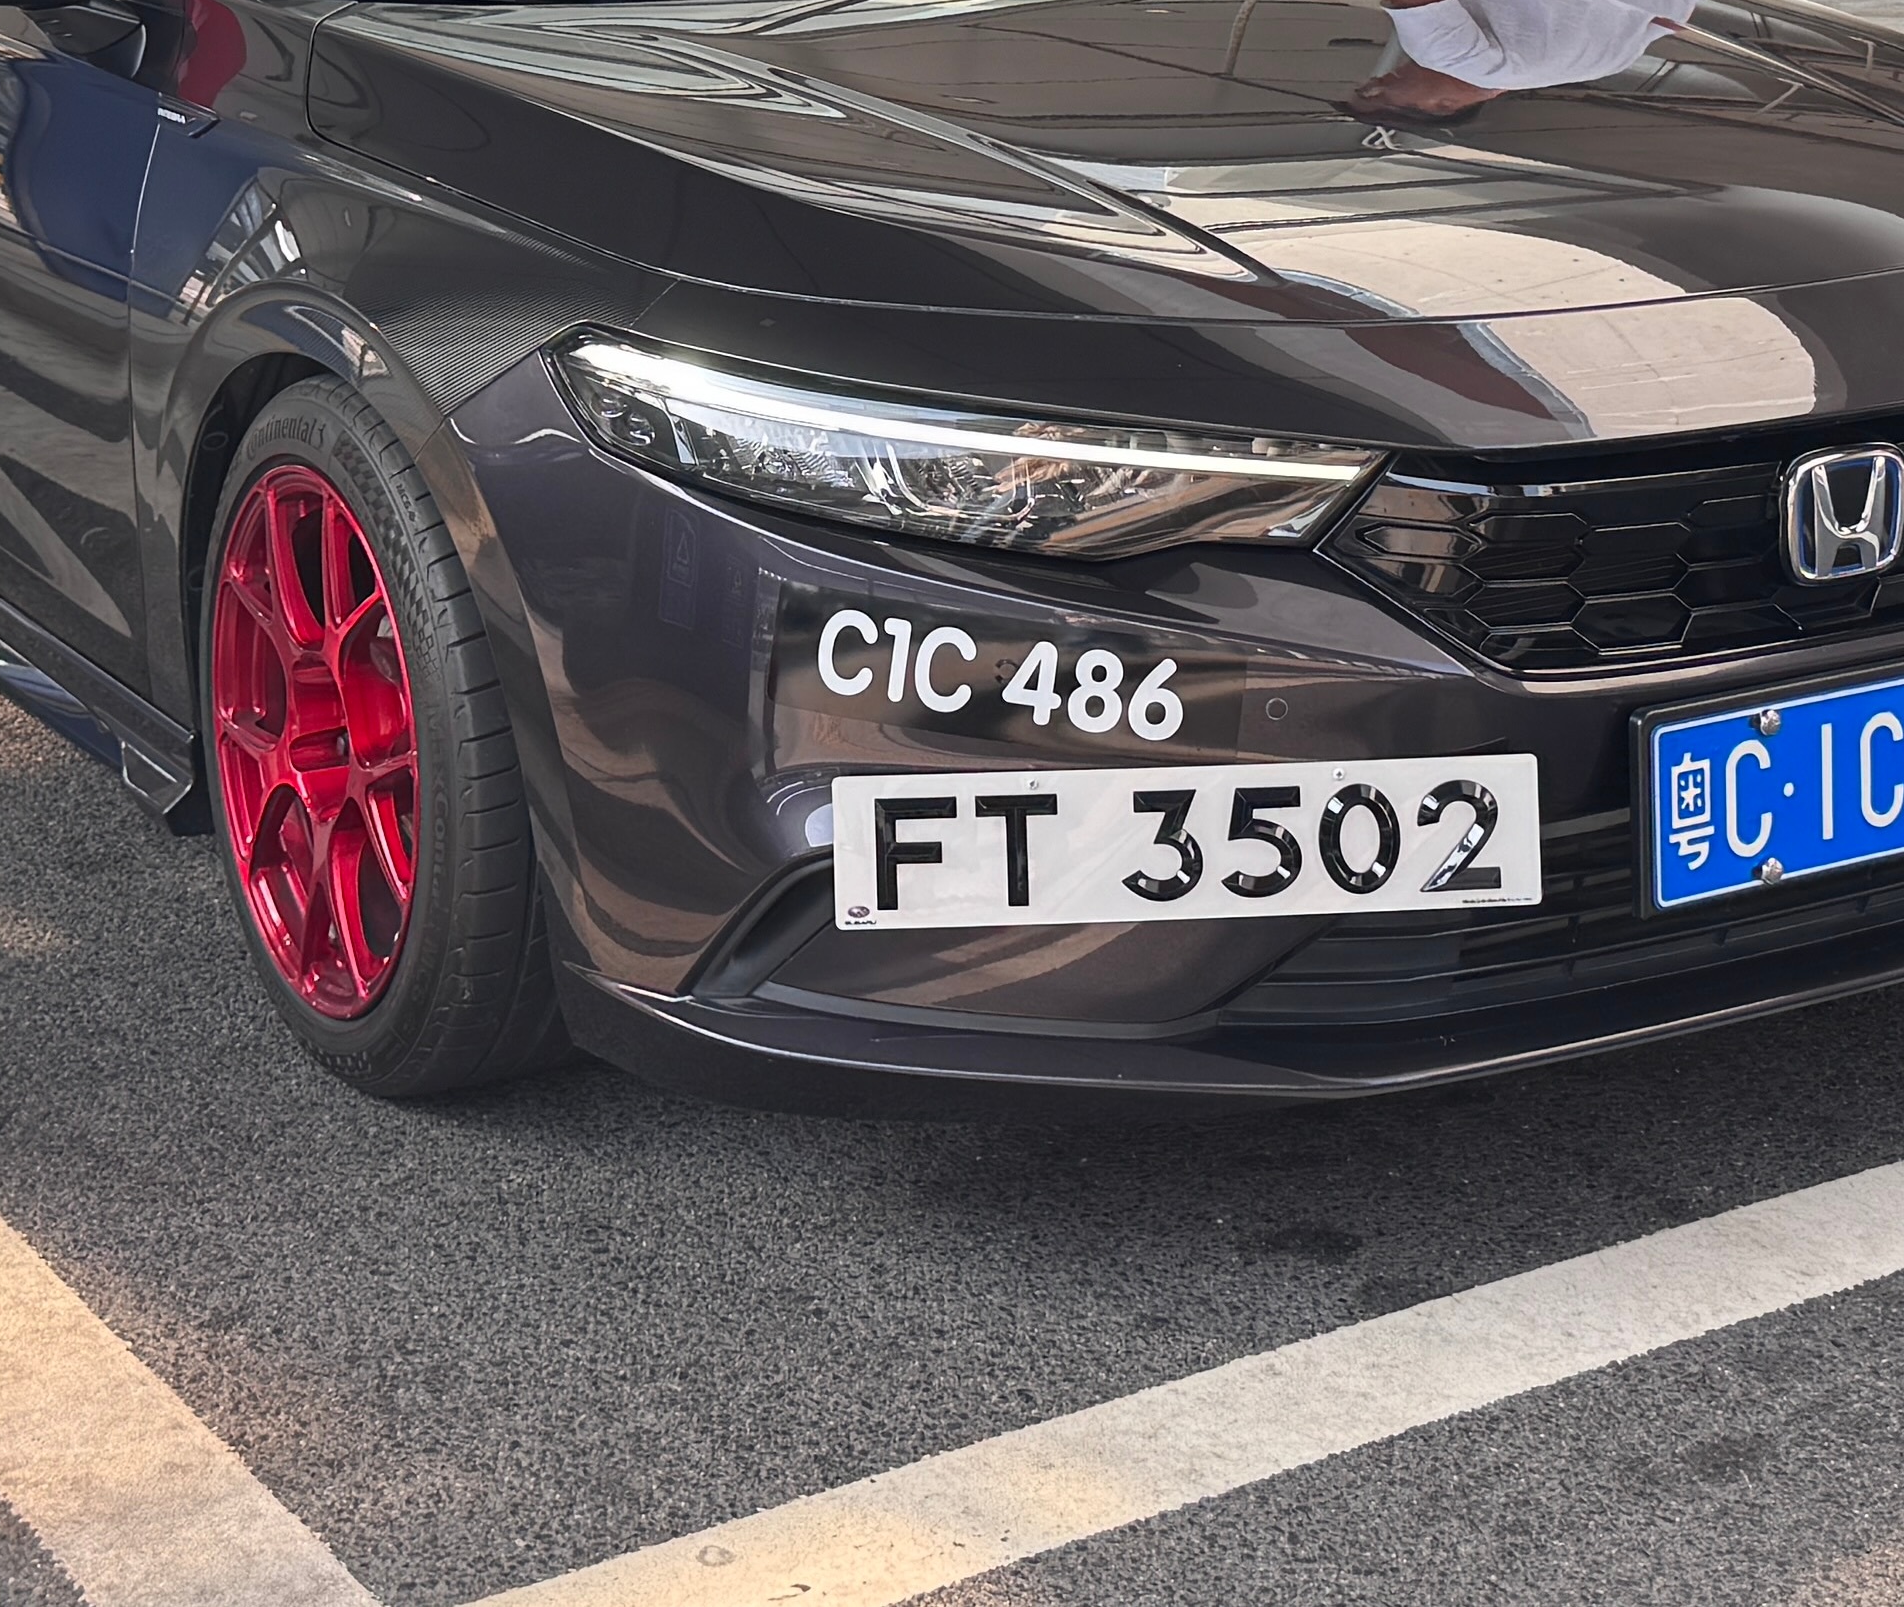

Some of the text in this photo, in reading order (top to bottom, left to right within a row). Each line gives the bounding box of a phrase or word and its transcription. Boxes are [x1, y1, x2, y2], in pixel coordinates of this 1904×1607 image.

[817, 608, 1185, 742] C1C 486
[874, 778, 1503, 911] FT 3502
